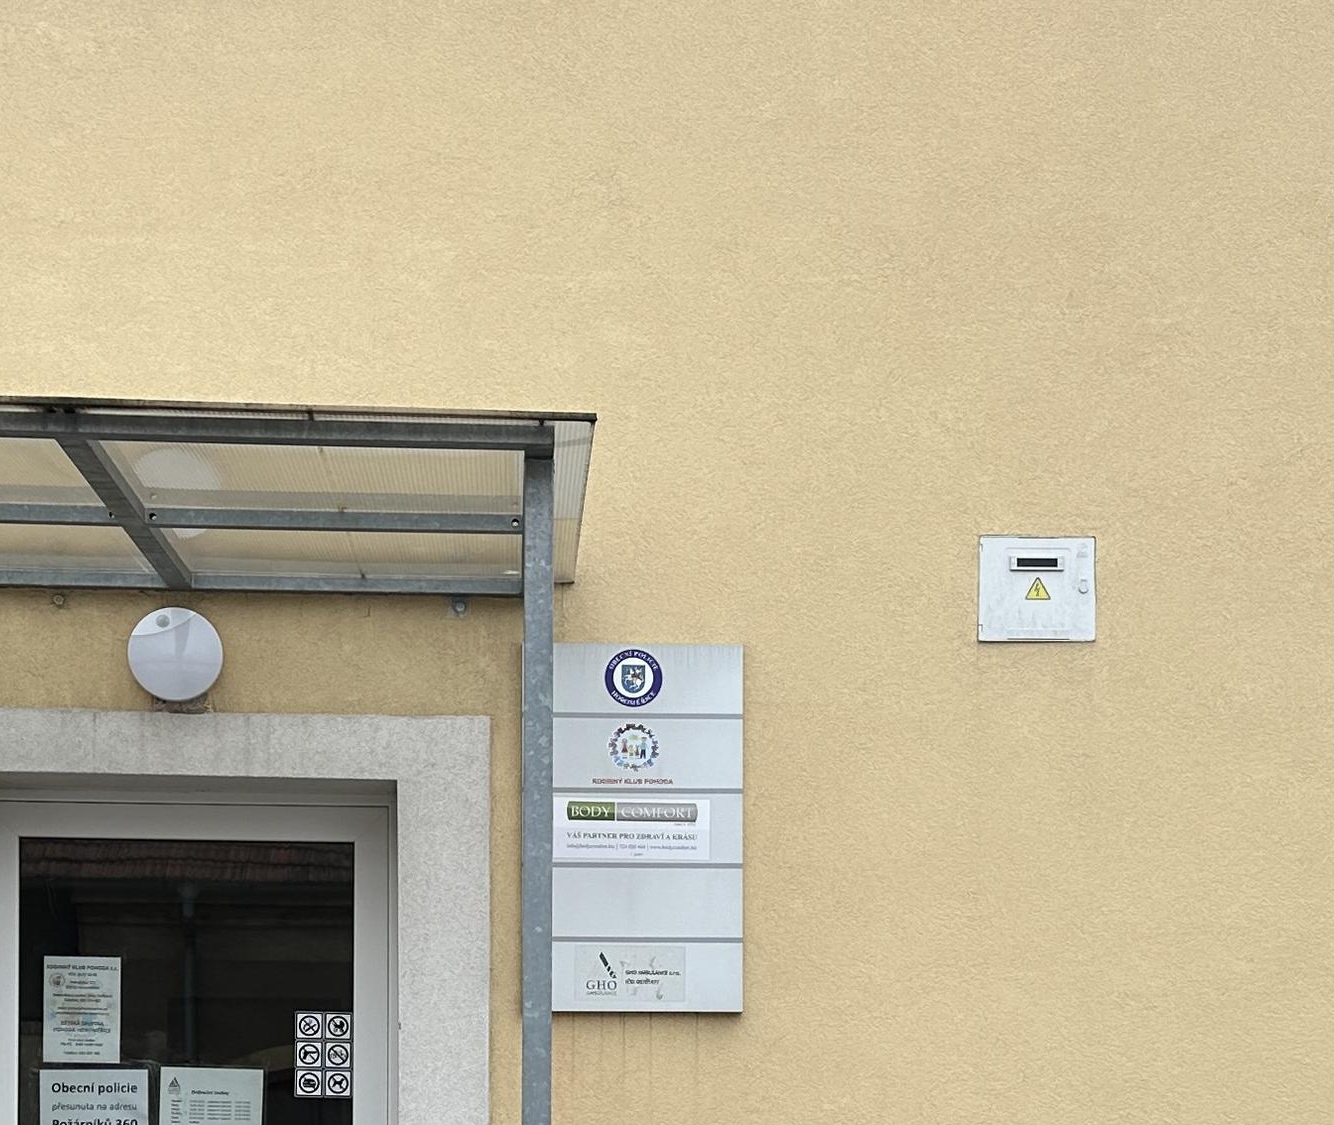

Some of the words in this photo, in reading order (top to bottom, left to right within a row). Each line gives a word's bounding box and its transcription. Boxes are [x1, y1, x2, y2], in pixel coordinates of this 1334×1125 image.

[570, 805, 611, 818] BODY
[620, 806, 693, 819] COMFORT
[582, 831, 618, 840] PARTNER
[619, 832, 635, 840] PRO
[586, 979, 618, 991] GHO
[51, 1082, 95, 1094] Obecní
[98, 1082, 138, 1096] policie
[51, 1101, 95, 1112] přesunuta
[96, 1103, 108, 1111] na
[109, 1101, 138, 1111] adresu
